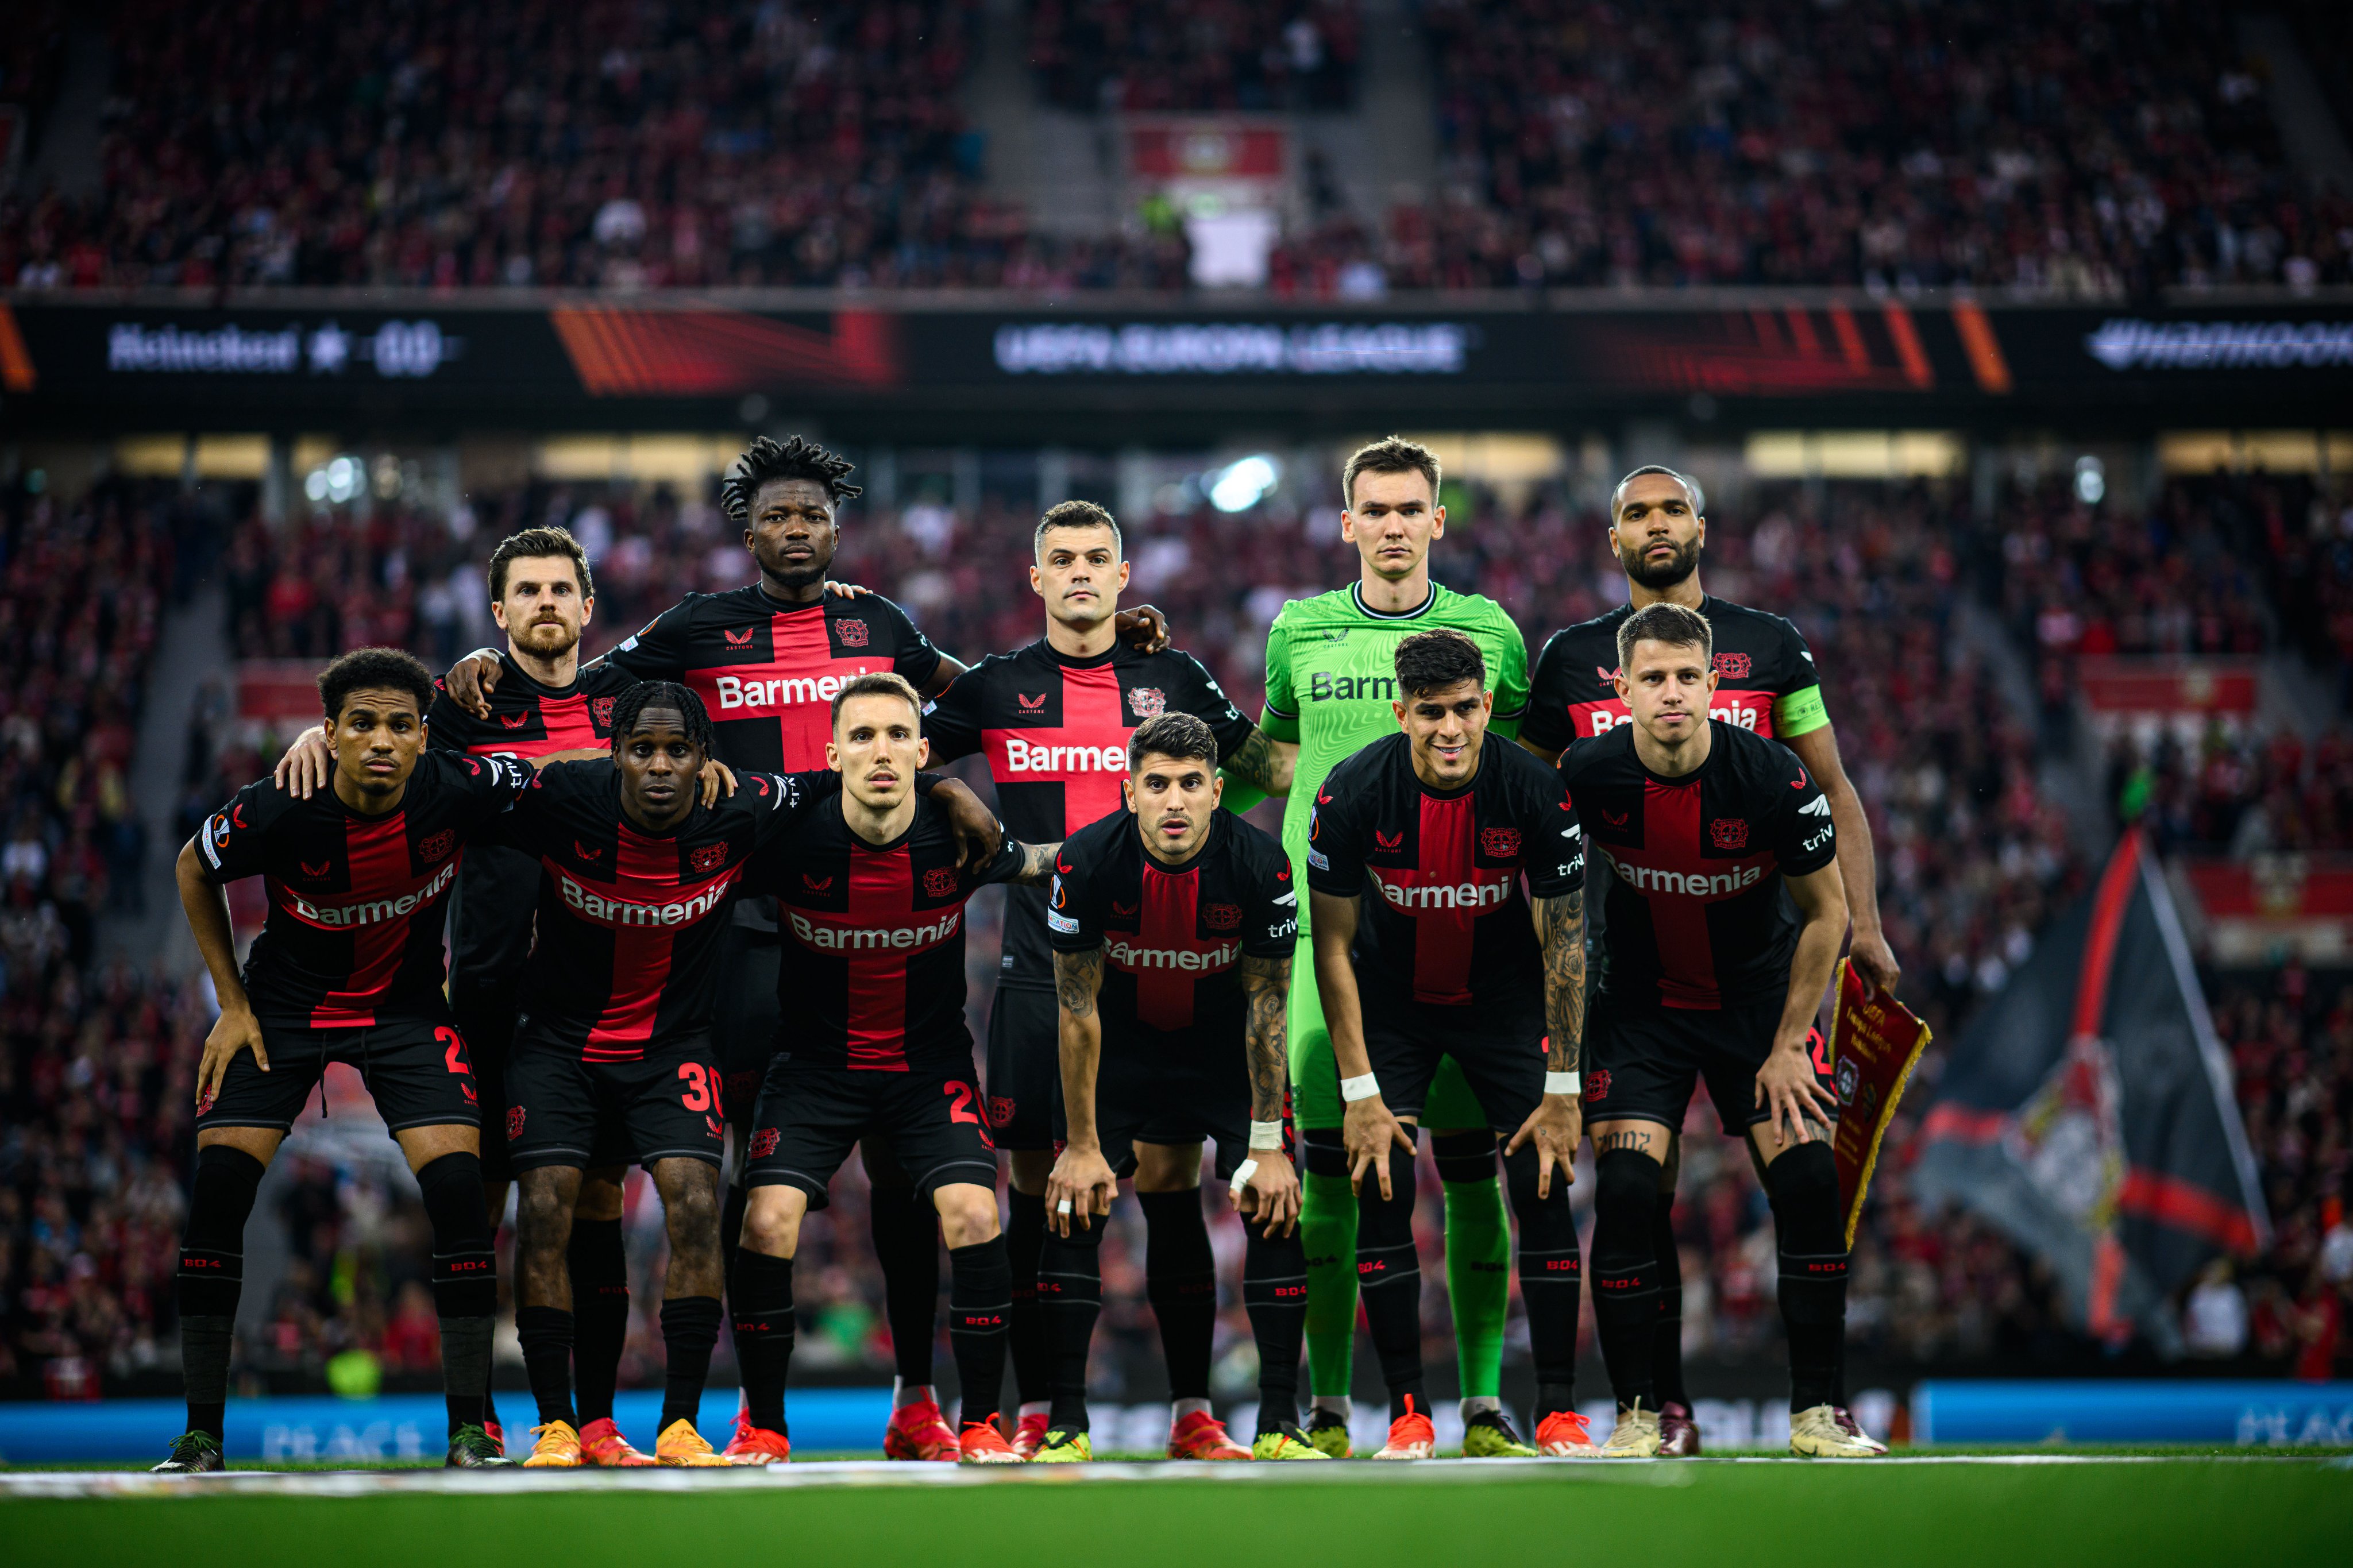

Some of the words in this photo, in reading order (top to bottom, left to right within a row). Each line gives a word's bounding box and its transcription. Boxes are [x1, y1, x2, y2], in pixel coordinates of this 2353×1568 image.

[716, 667, 866, 709] Barme
[1006, 739, 1130, 773] Barme
[292, 863, 453, 925] Barmenia
[1368, 868, 1511, 908] Barmeni
[561, 876, 728, 925] Barmenia
[789, 911, 960, 949] Barmenia
[434, 1026, 476, 1080] 2
[184, 1258, 221, 1268] B04
[451, 1261, 488, 1272] B04
[1545, 1260, 1579, 1270] B04
[1808, 1262, 1846, 1272] B04
[1274, 1285, 1307, 1296] B04
[1601, 1277, 1641, 1289] B04
[966, 1315, 1002, 1326] B04
